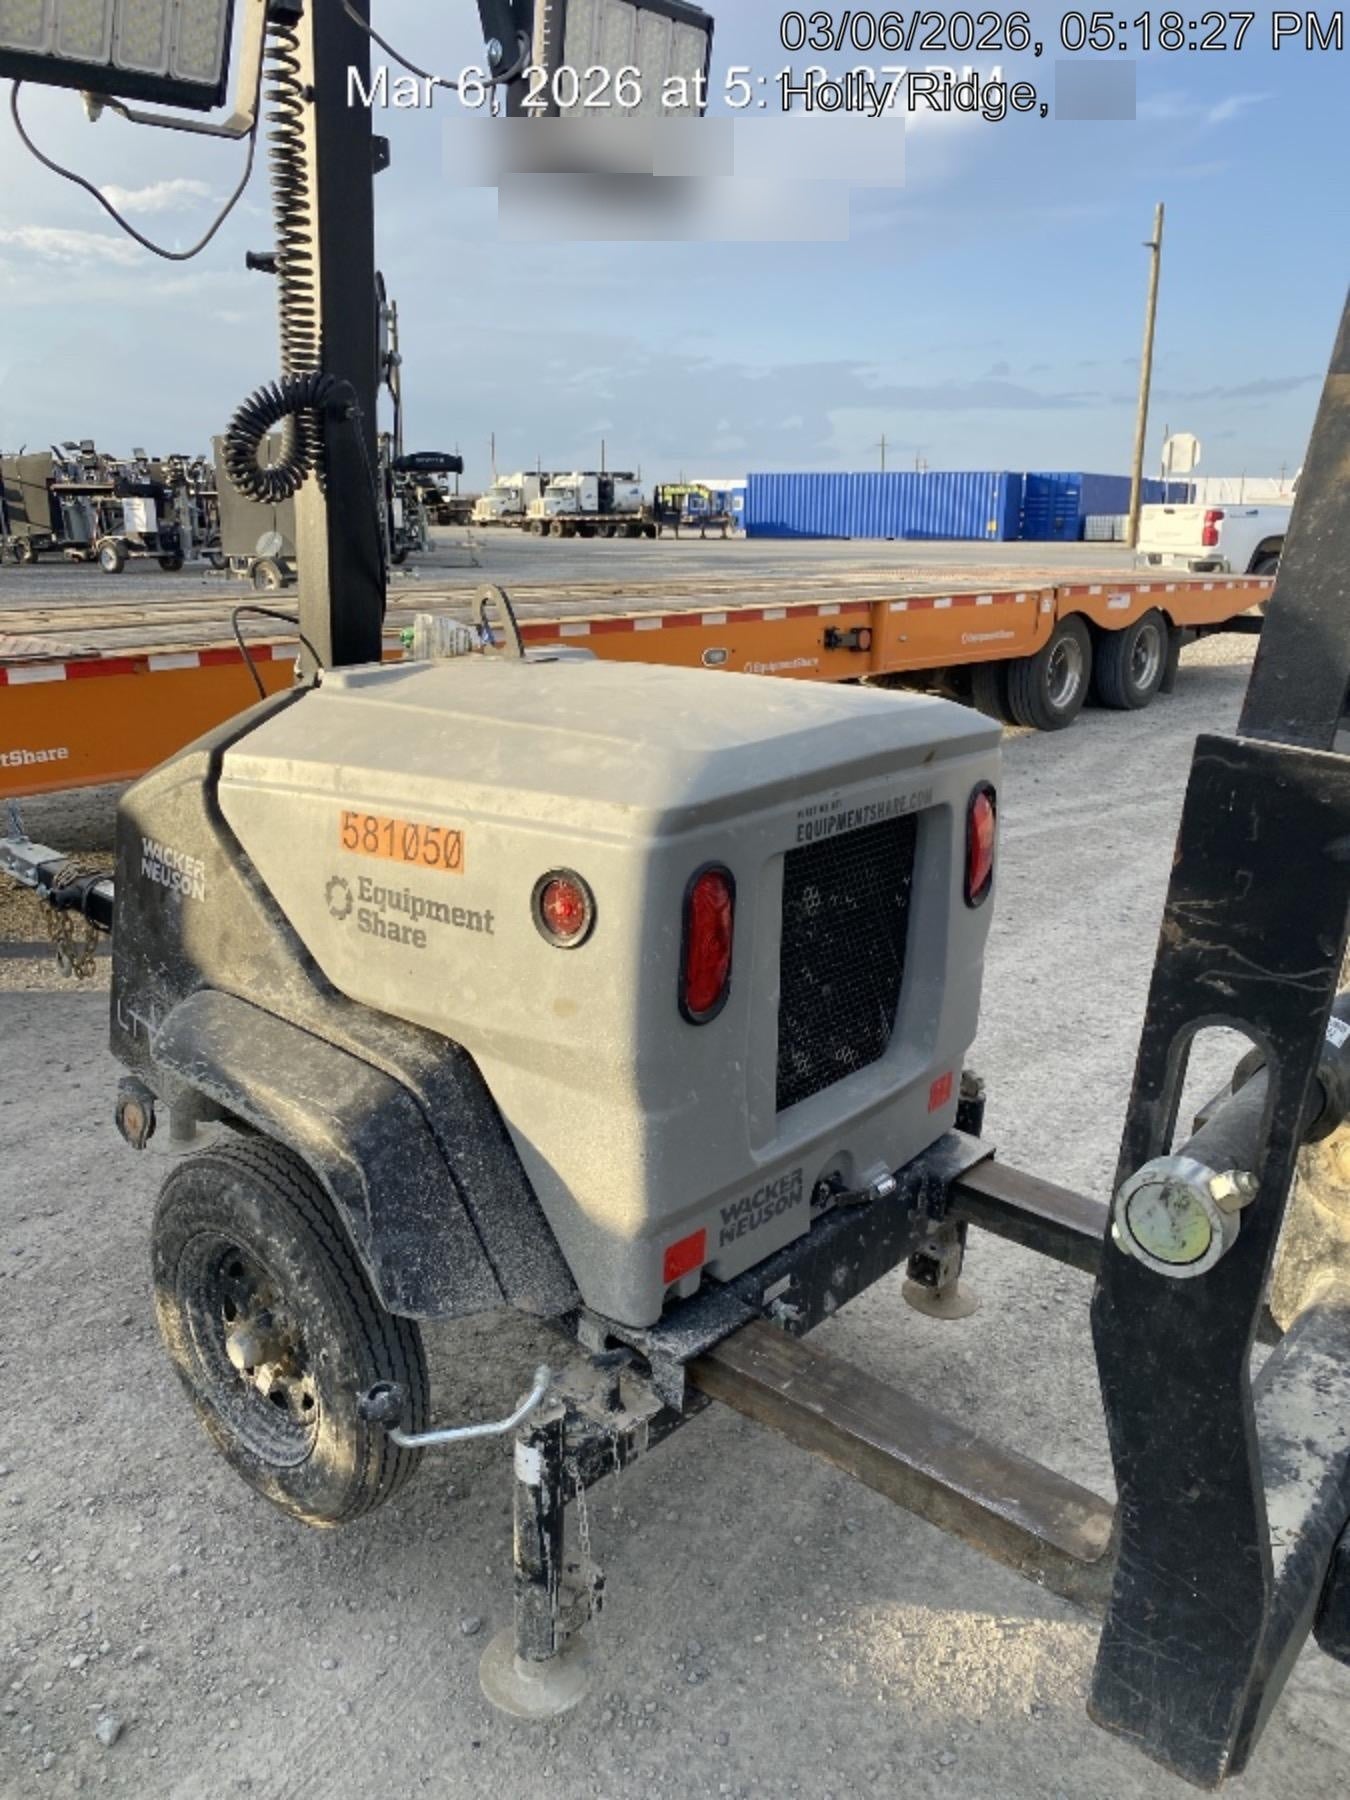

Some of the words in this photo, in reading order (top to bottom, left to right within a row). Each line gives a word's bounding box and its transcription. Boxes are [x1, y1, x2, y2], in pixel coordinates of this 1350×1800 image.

[141, 837, 205, 881] WACKER
[343, 811, 461, 869] 581050
[141, 856, 205, 902] NEUSON
[357, 875, 495, 935] Equipment
[357, 907, 427, 948] Share
[720, 1168, 802, 1225] WACKER
[720, 1184, 802, 1247] NEUSON
